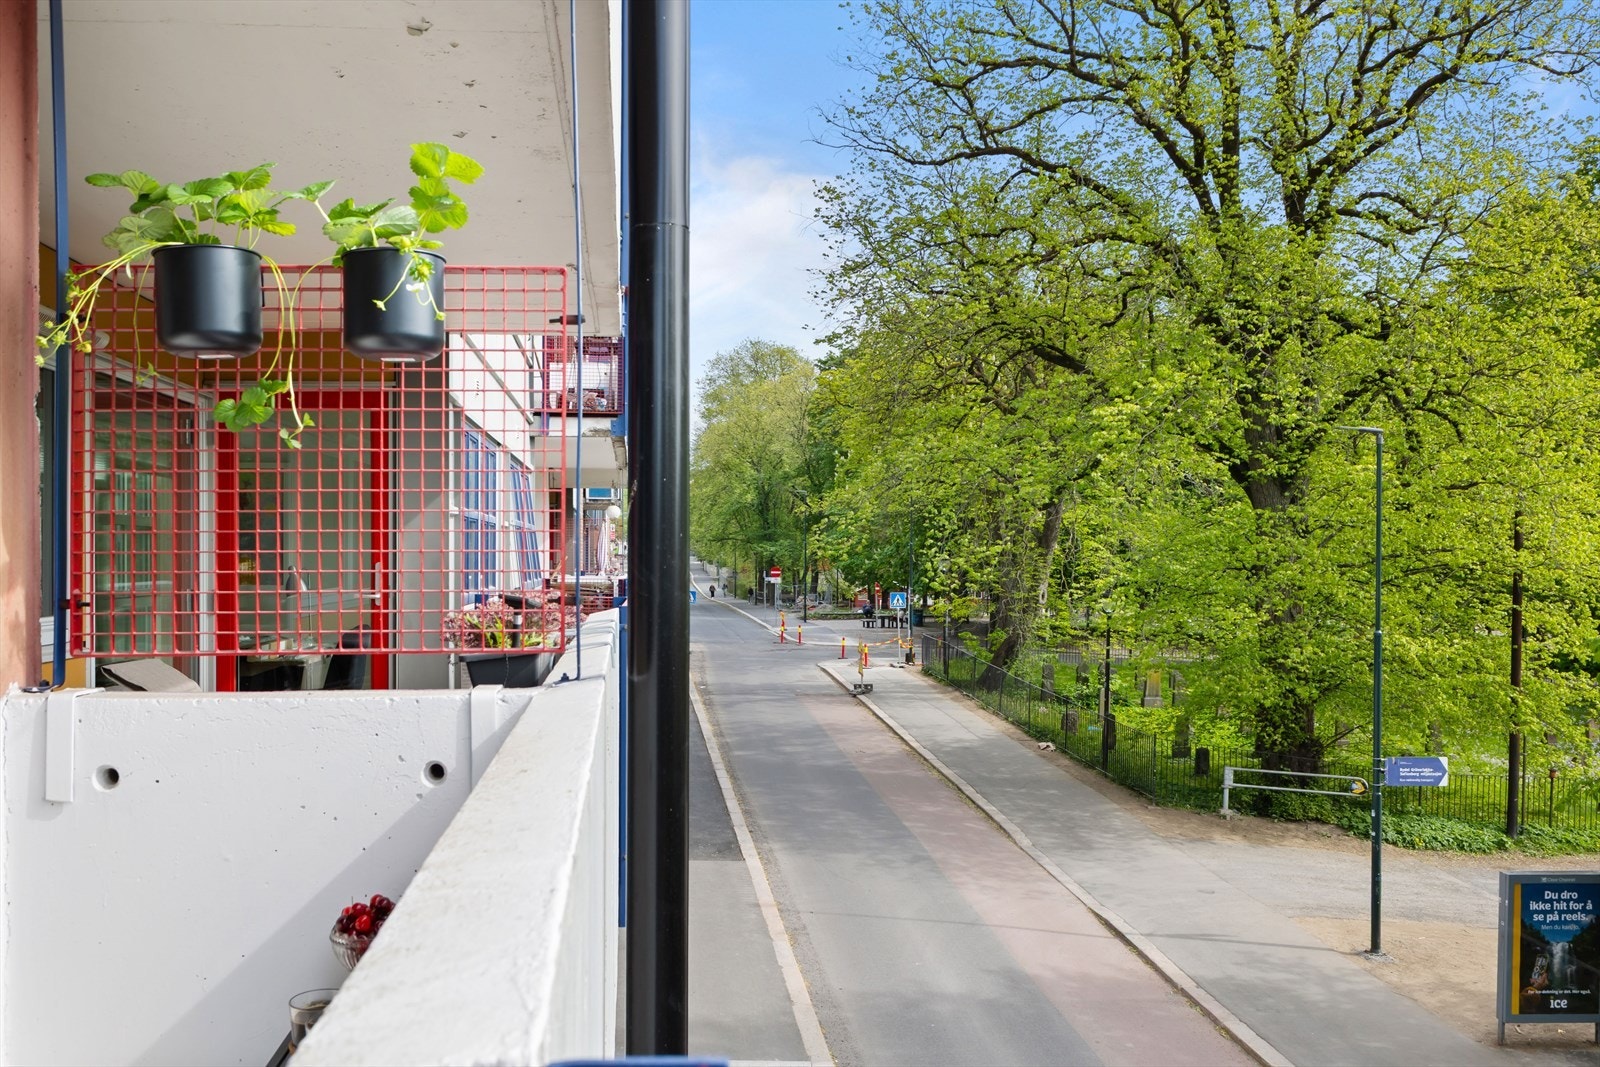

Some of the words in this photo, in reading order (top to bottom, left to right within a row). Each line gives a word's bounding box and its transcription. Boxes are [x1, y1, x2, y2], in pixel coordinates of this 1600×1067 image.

[1544, 891, 1558, 899] Du
[1560, 890, 1578, 899] dro
[1529, 901, 1551, 910] ikke
[1553, 901, 1567, 910] hit
[1569, 901, 1584, 910] for
[1586, 900, 1593, 910] å
[1533, 913, 1545, 921] se
[1546, 911, 1559, 923] på
[1561, 912, 1589, 921] reels.
[1549, 996, 1568, 1009] ice
